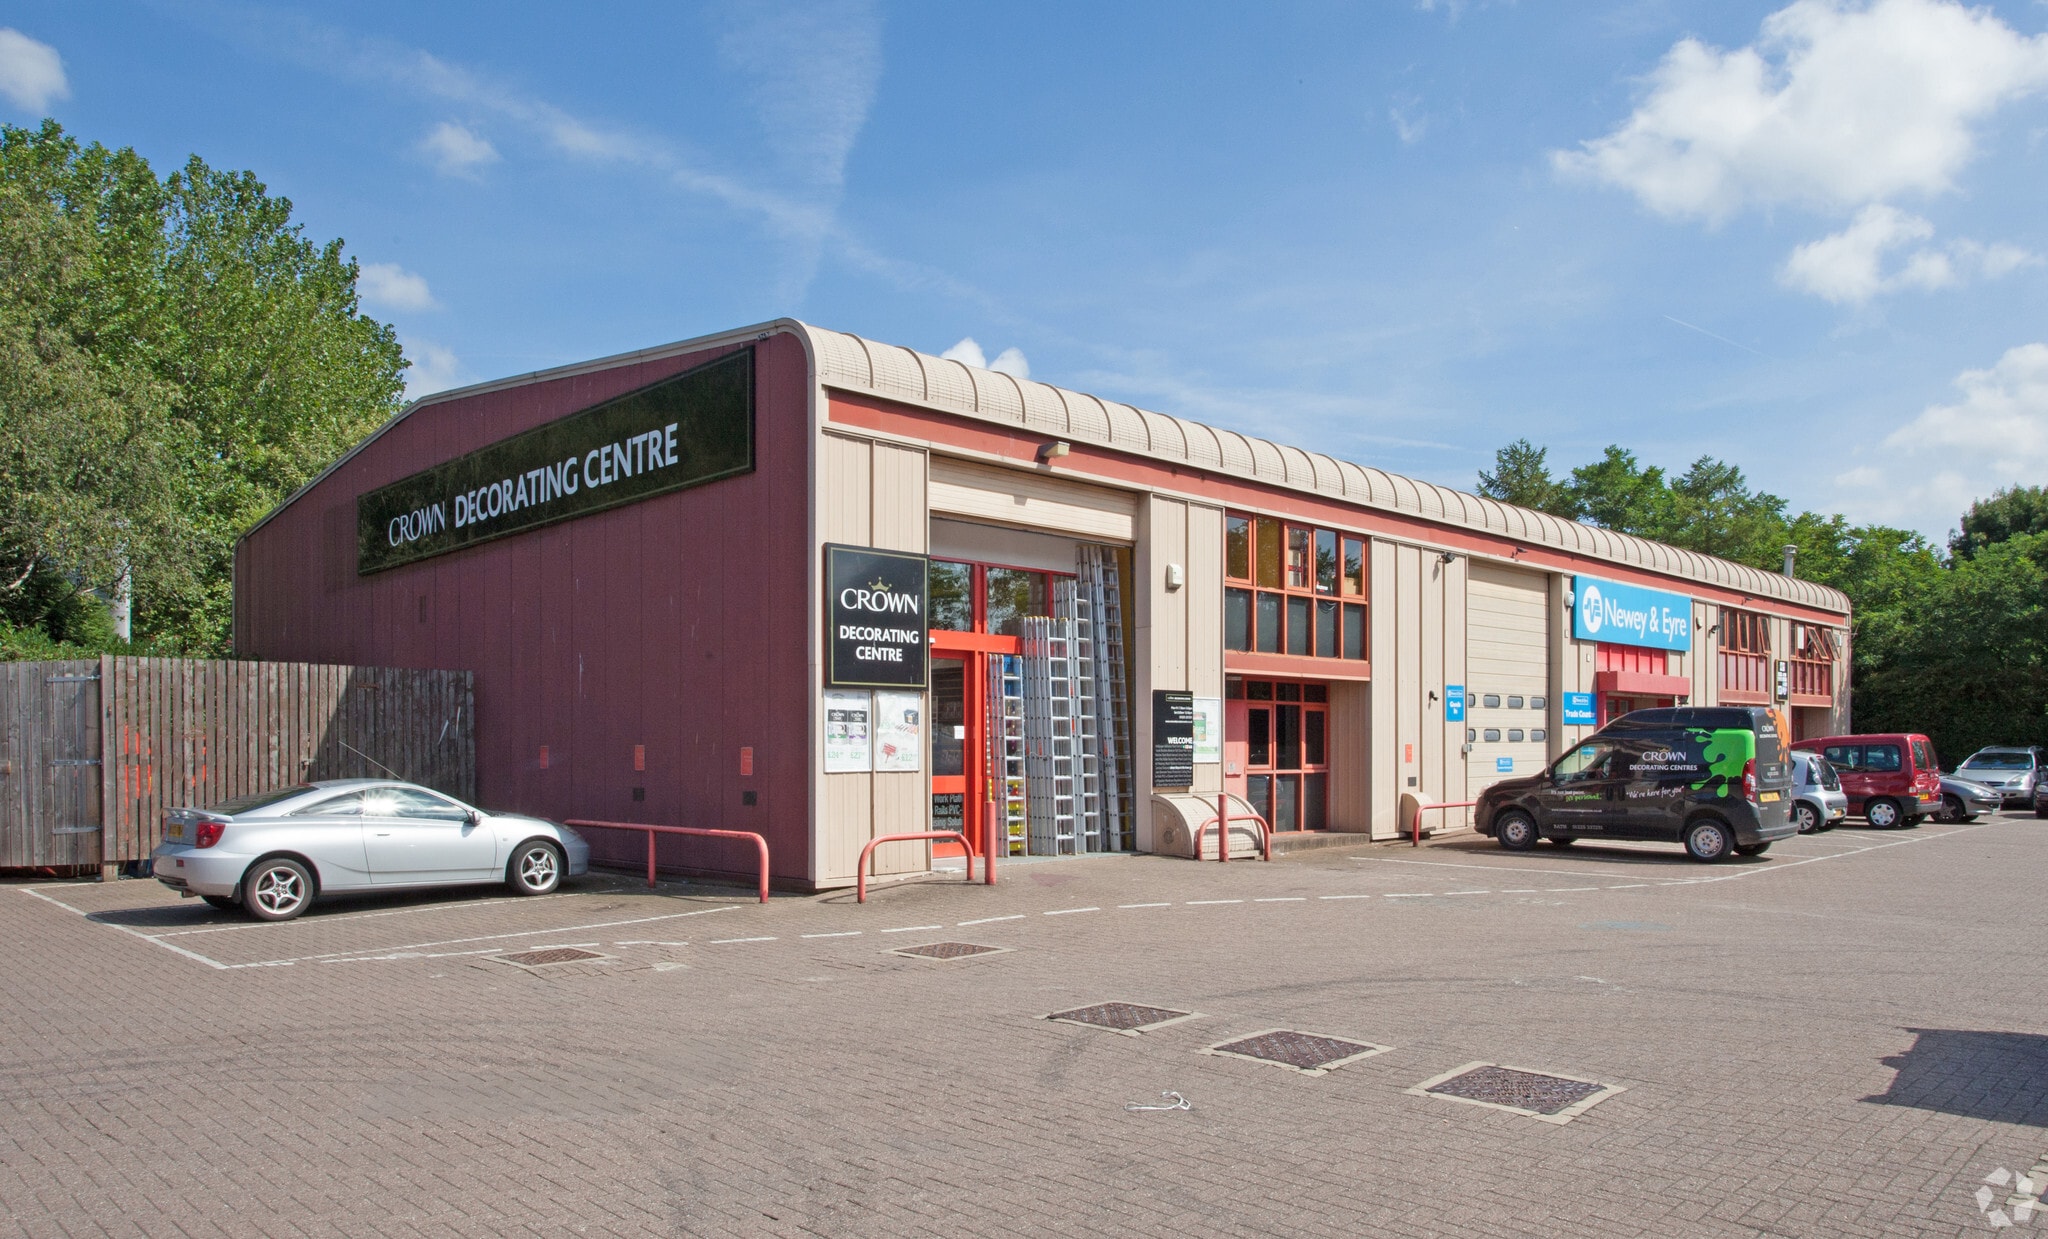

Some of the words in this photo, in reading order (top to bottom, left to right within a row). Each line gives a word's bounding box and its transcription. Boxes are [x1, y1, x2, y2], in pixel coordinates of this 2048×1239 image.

[389, 501, 446, 547] CROWN
[455, 457, 579, 528] DECORATING
[584, 423, 679, 489] CENTRE
[840, 588, 918, 615] CROWN
[1604, 597, 1648, 639] Newey
[1649, 606, 1659, 633] &
[1662, 607, 1687, 643] Eyre
[839, 625, 919, 644] DECORATING
[855, 646, 903, 662] CENTRE
[1565, 709, 1579, 718] Trade
[1167, 736, 1193, 745] WELCOME
[1642, 751, 1687, 762] CROWN
[934, 794, 949, 804] Work
[1647, 788, 1660, 797] here
[1661, 786, 1671, 799] for
